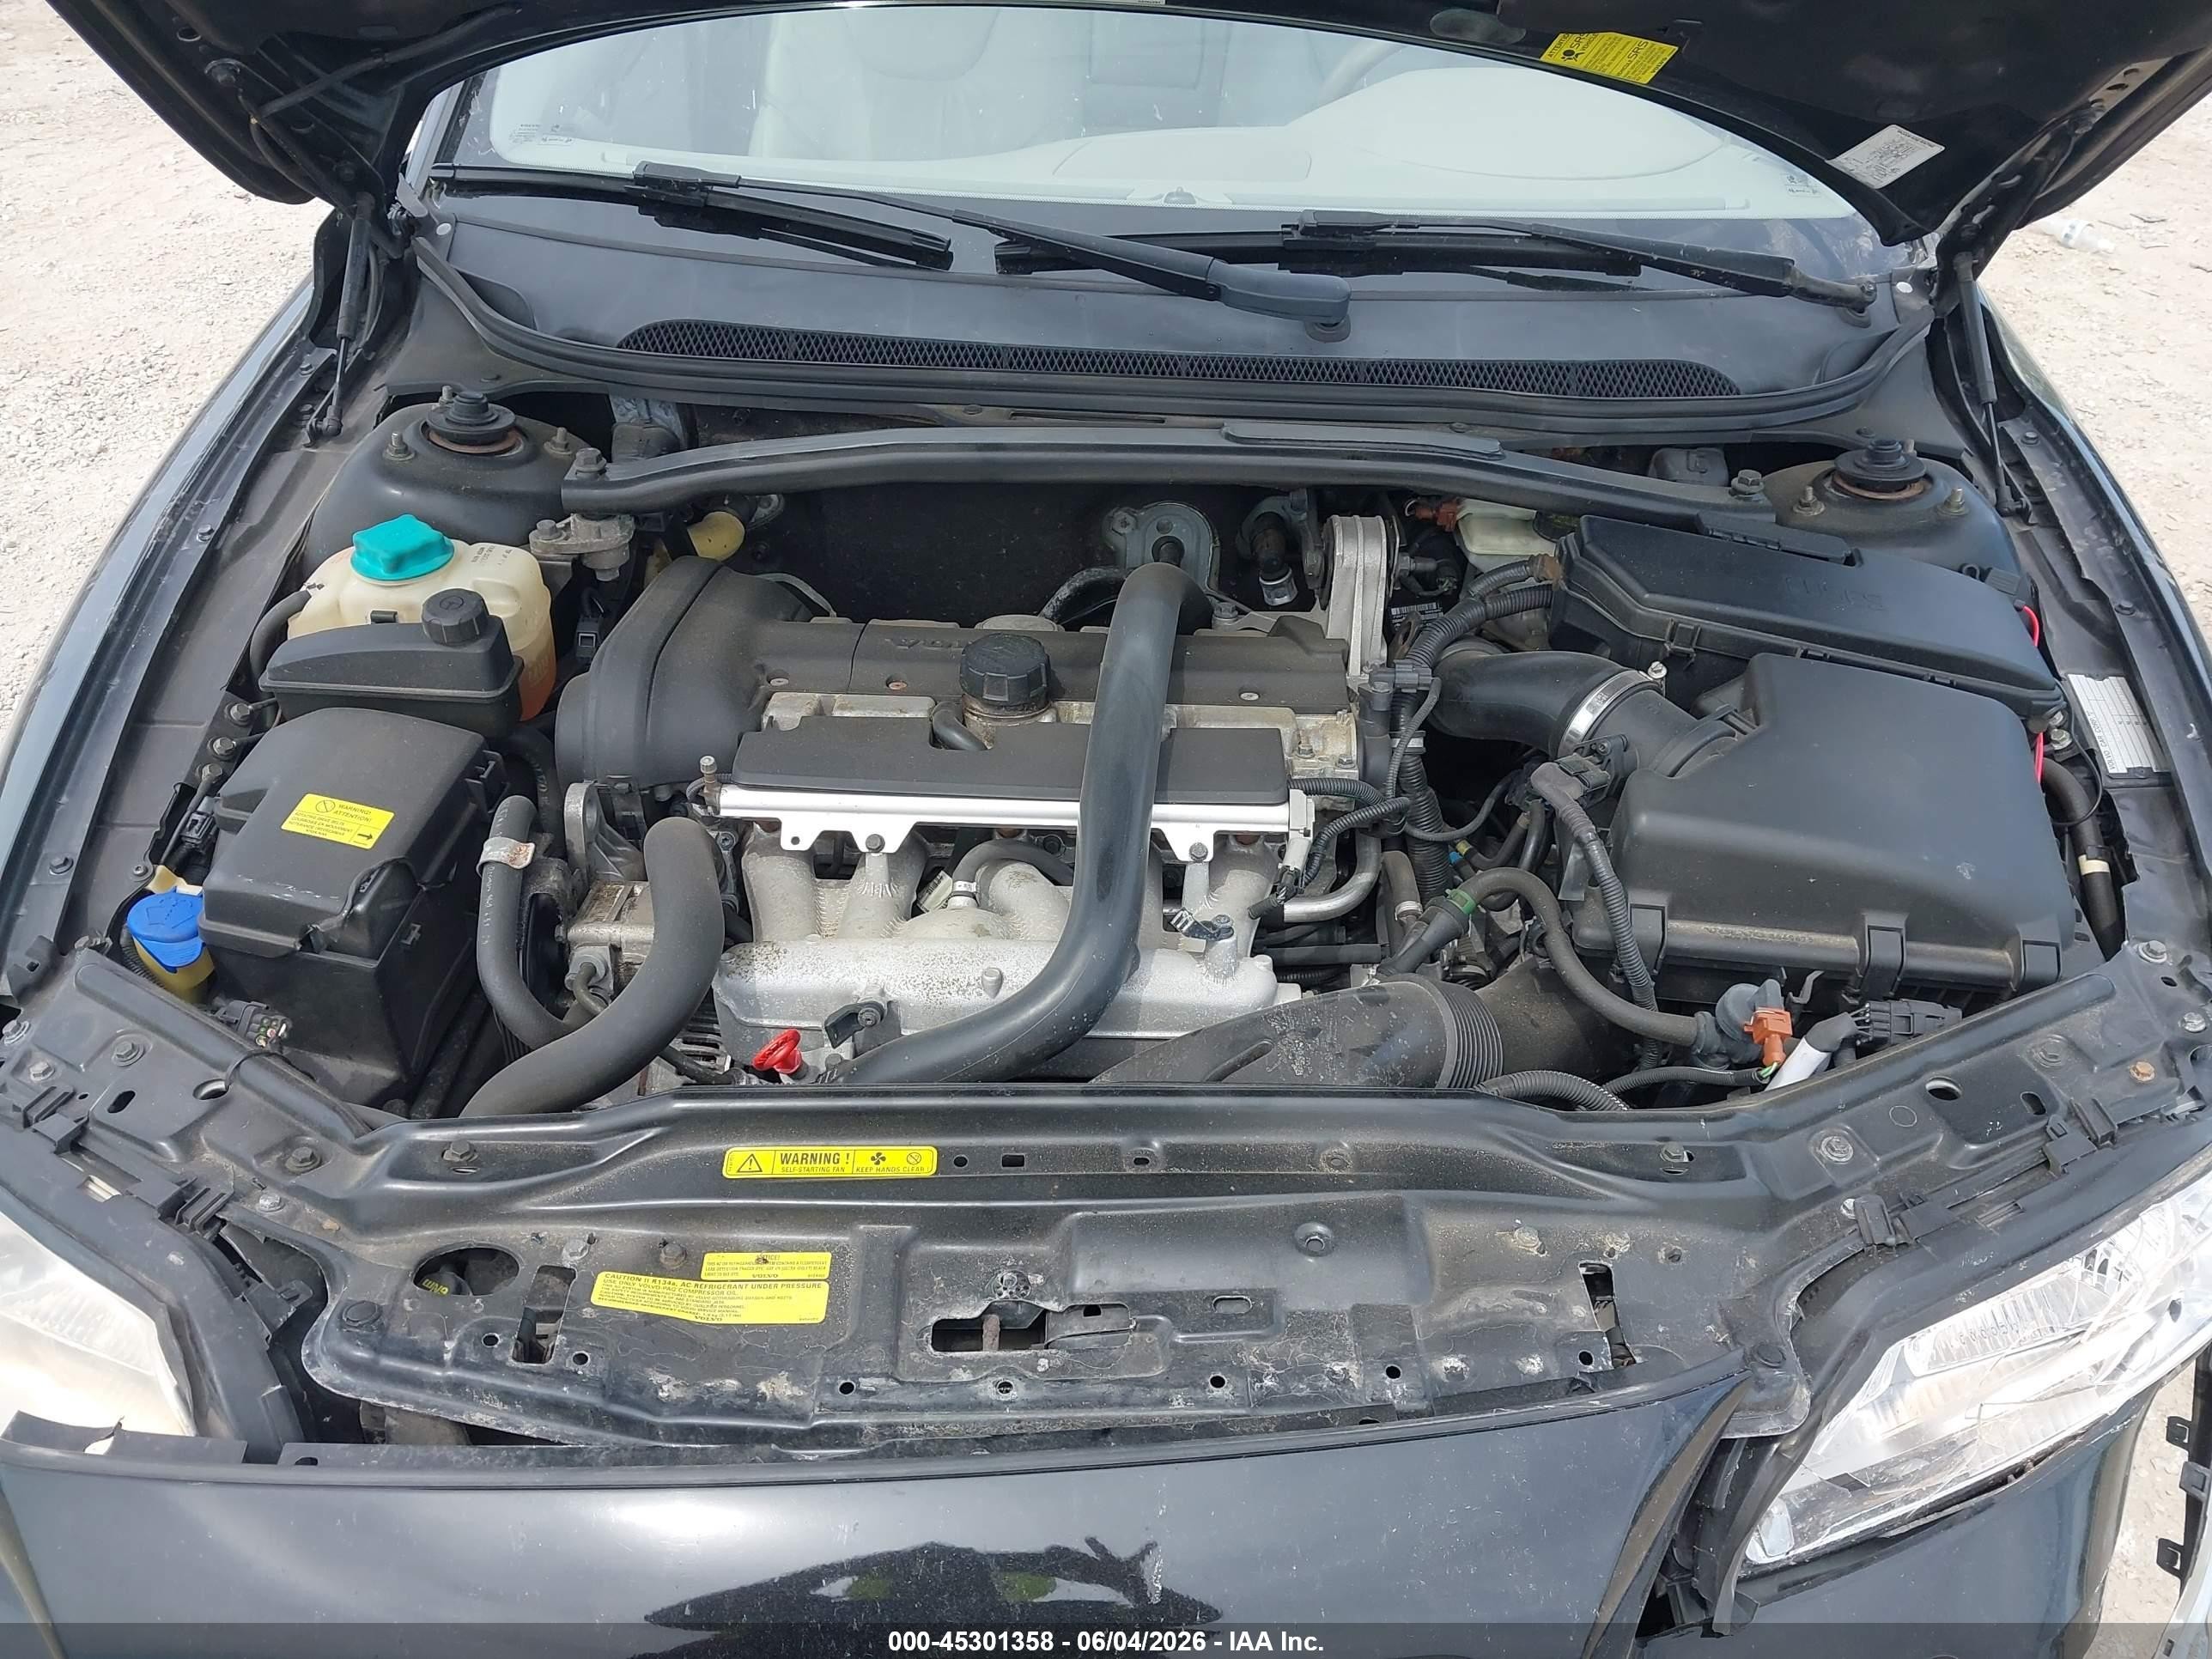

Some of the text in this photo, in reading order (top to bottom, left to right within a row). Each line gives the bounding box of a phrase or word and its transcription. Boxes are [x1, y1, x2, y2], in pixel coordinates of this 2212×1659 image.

[1628, 40, 1649, 60] SRS
[780, 1152, 840, 1165] WARNING
[605, 1273, 642, 1282] CAUTION
[678, 1287, 725, 1296] COMPRESSOR
